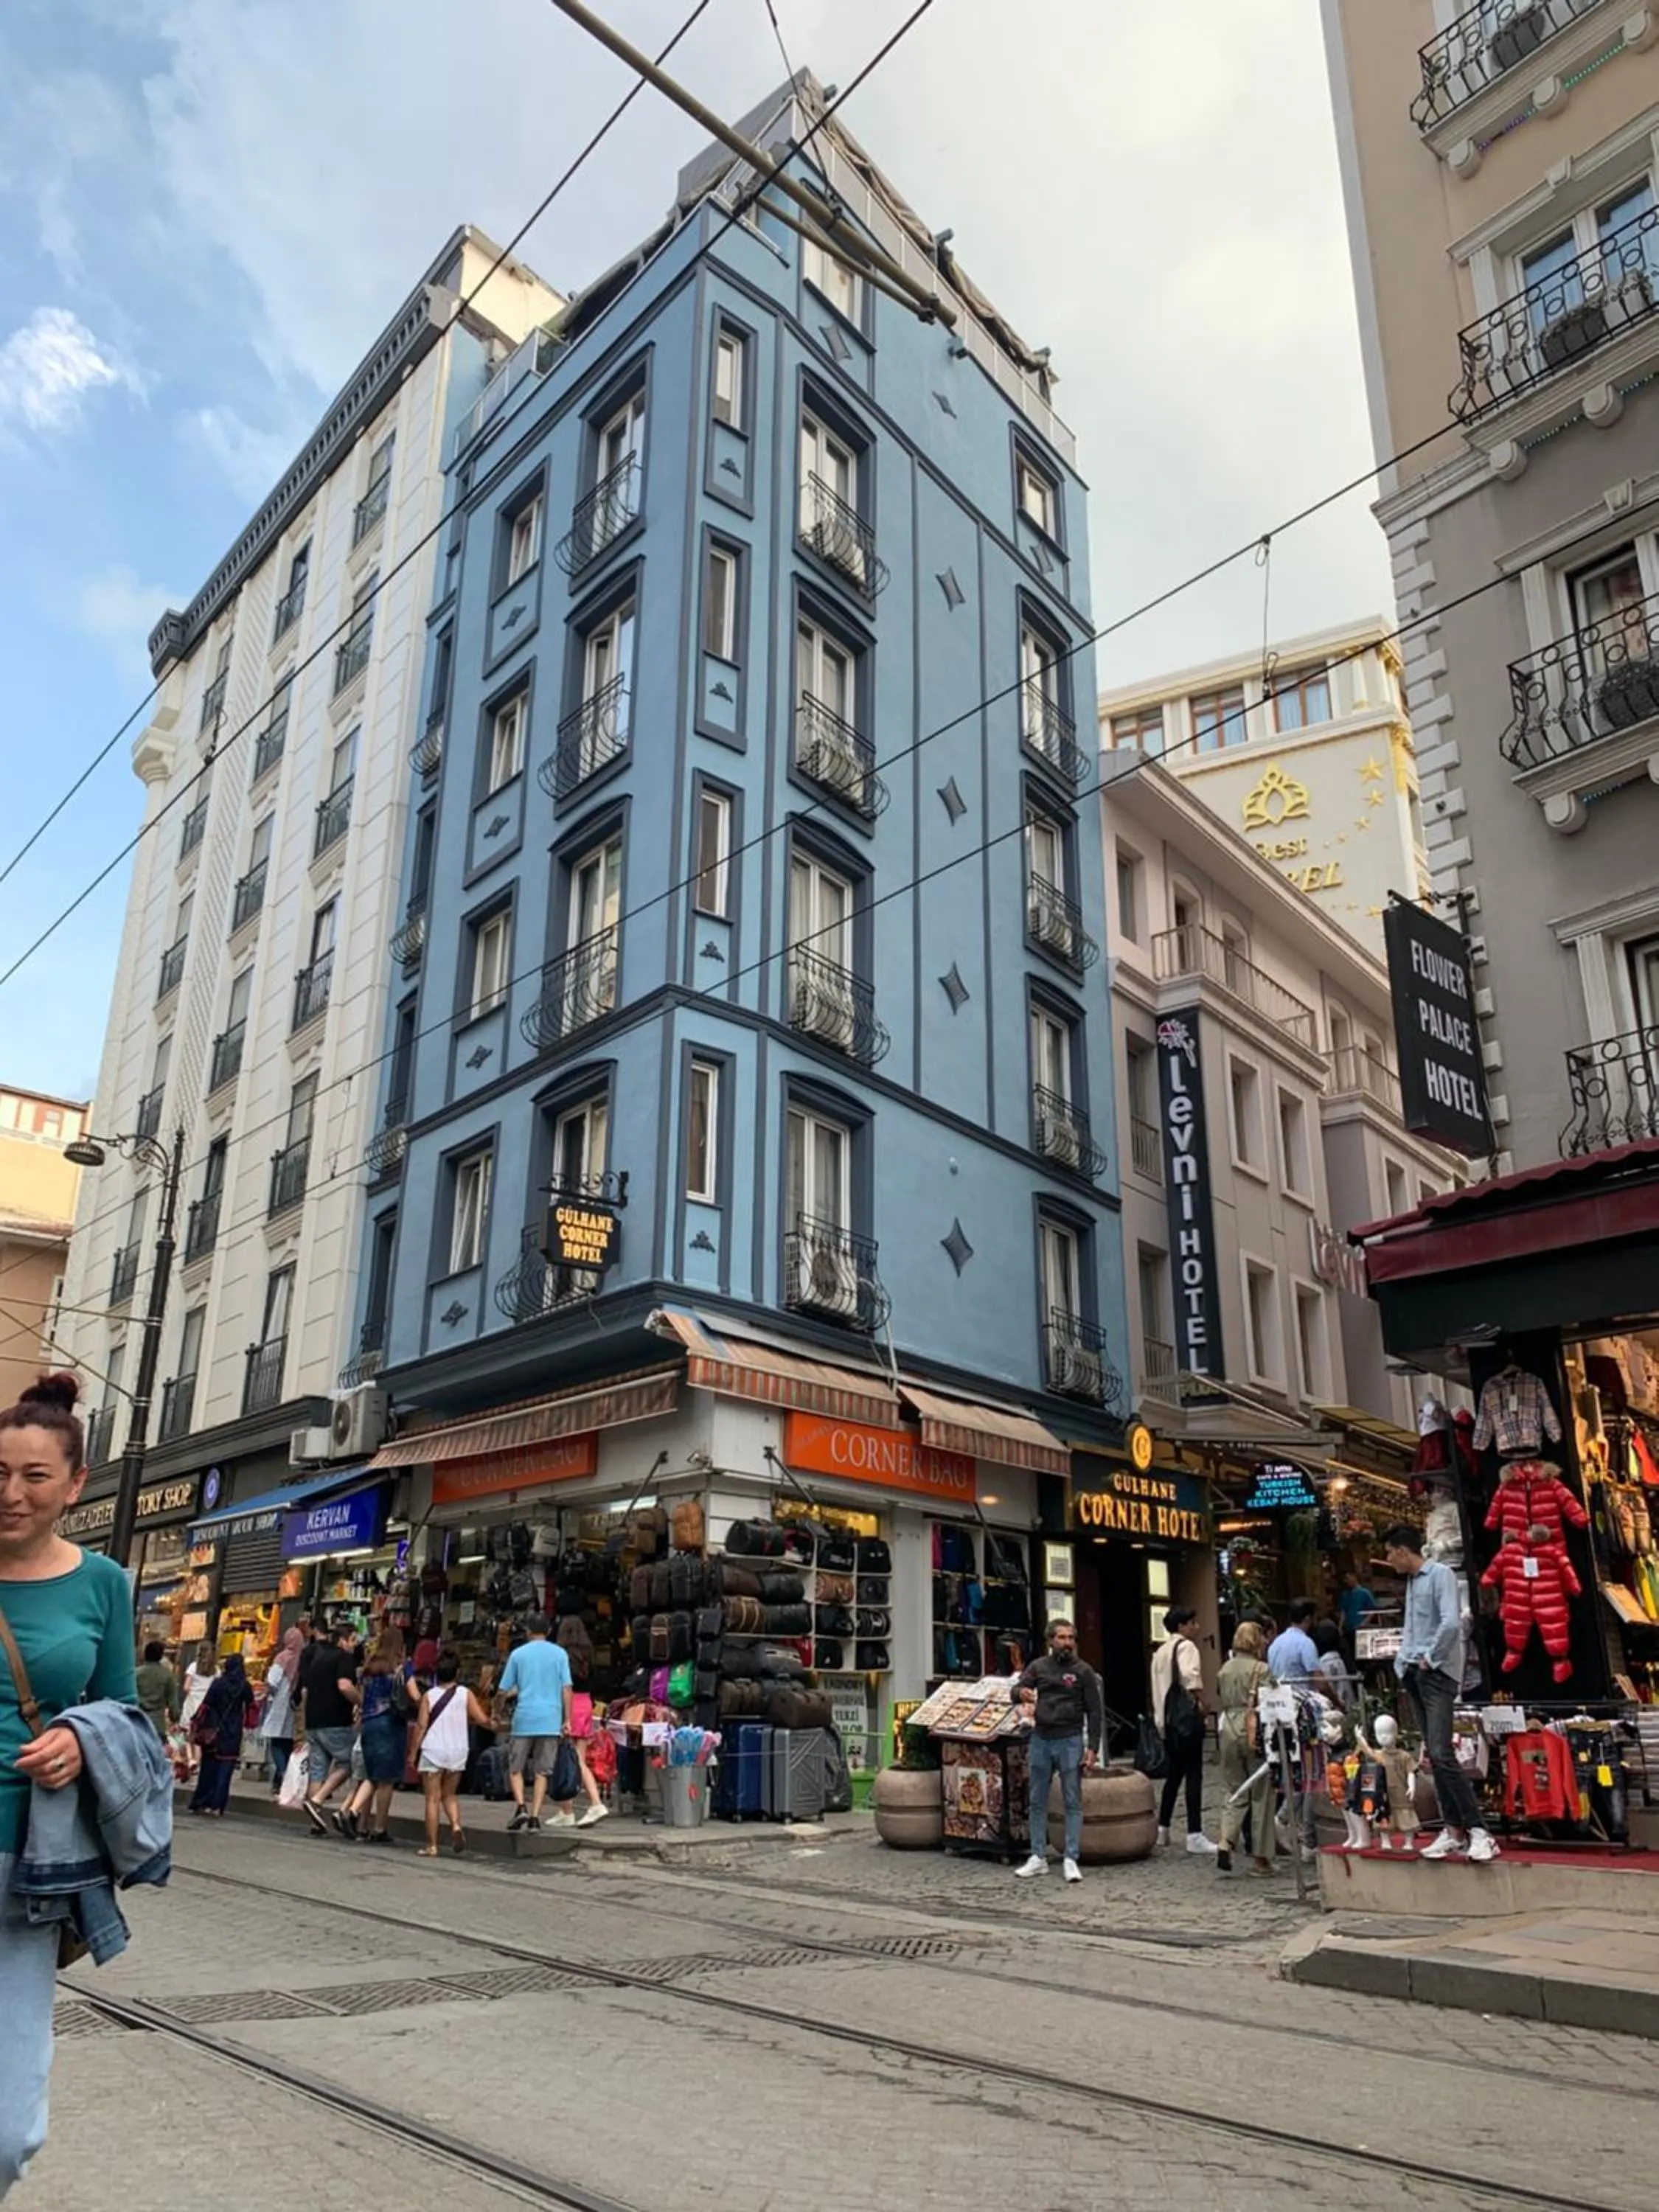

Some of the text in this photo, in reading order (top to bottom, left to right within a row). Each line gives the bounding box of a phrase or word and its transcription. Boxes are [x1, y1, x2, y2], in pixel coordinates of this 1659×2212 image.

[1411, 939, 1467, 1000] FLOWER
[1419, 998, 1474, 1056] PALACE
[1425, 1057, 1484, 1121] HOTEL
[559, 1224, 608, 1248] CORNER
[563, 1242, 603, 1264] HOTEL
[1179, 1228, 1209, 1374] HOTEL
[831, 1428, 923, 1481] CORNER
[930, 1450, 967, 1489] BAG
[163, 1483, 192, 1510] SHOP
[1255, 1487, 1306, 1498] KITCHEN
[1281, 1495, 1316, 1506] HOUSE
[306, 1503, 352, 1530] KERVAN
[1079, 1492, 1152, 1534] CORNER
[295, 1524, 358, 1547] DISCOUNT MARKET
